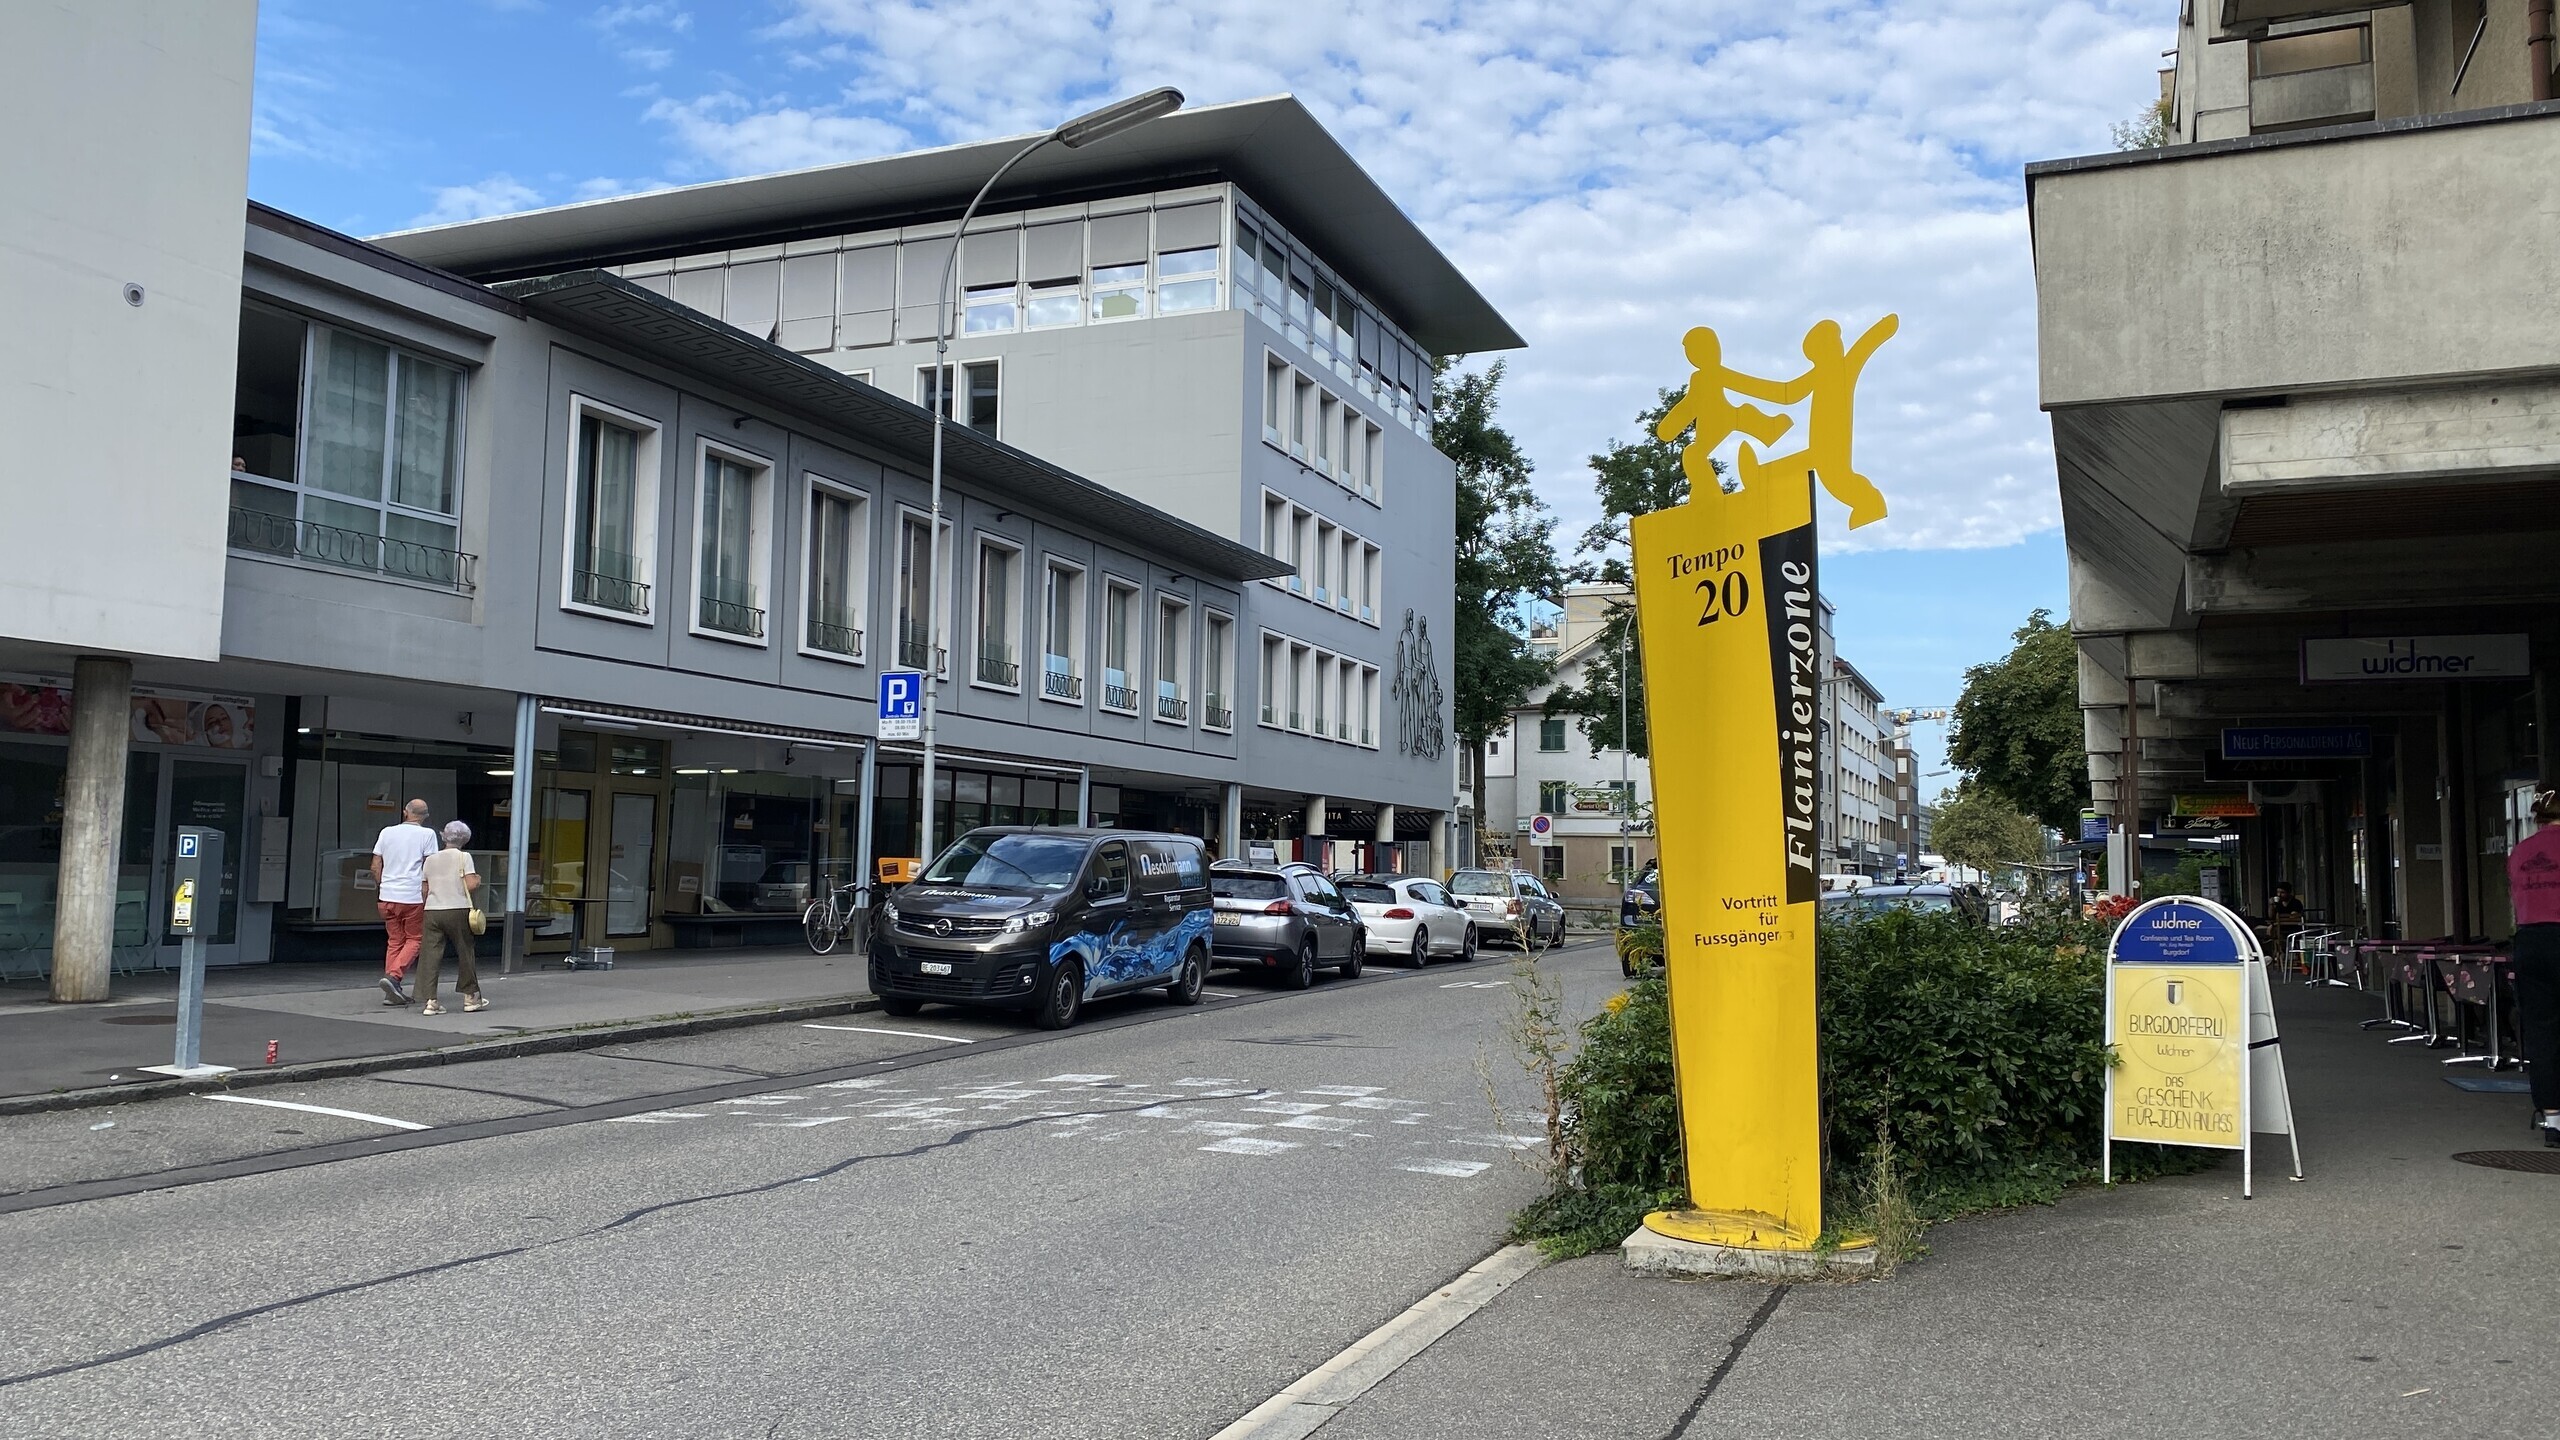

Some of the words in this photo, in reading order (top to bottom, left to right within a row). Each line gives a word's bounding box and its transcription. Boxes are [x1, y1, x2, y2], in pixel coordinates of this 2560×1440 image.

[1666, 544, 1745, 580] Tempo
[1694, 571, 1750, 627] 20
[2362, 639, 2475, 675] widmer
[887, 679, 908, 713] P
[1780, 560, 1815, 874] Flanierzone
[183, 837, 196, 855] P
[1721, 894, 1779, 911] Vortritt
[1758, 911, 1779, 926] für
[2151, 910, 2203, 929] widmer
[1694, 929, 1780, 948] Fussgänger
[2183, 934, 2194, 942] Tea
[2163, 949, 2190, 957] Burgdorf
[2129, 1013, 2224, 1037] BURGDORFERLI
[2165, 1076, 2185, 1089] DAS
[2136, 1086, 2214, 1111] GESCHENK
